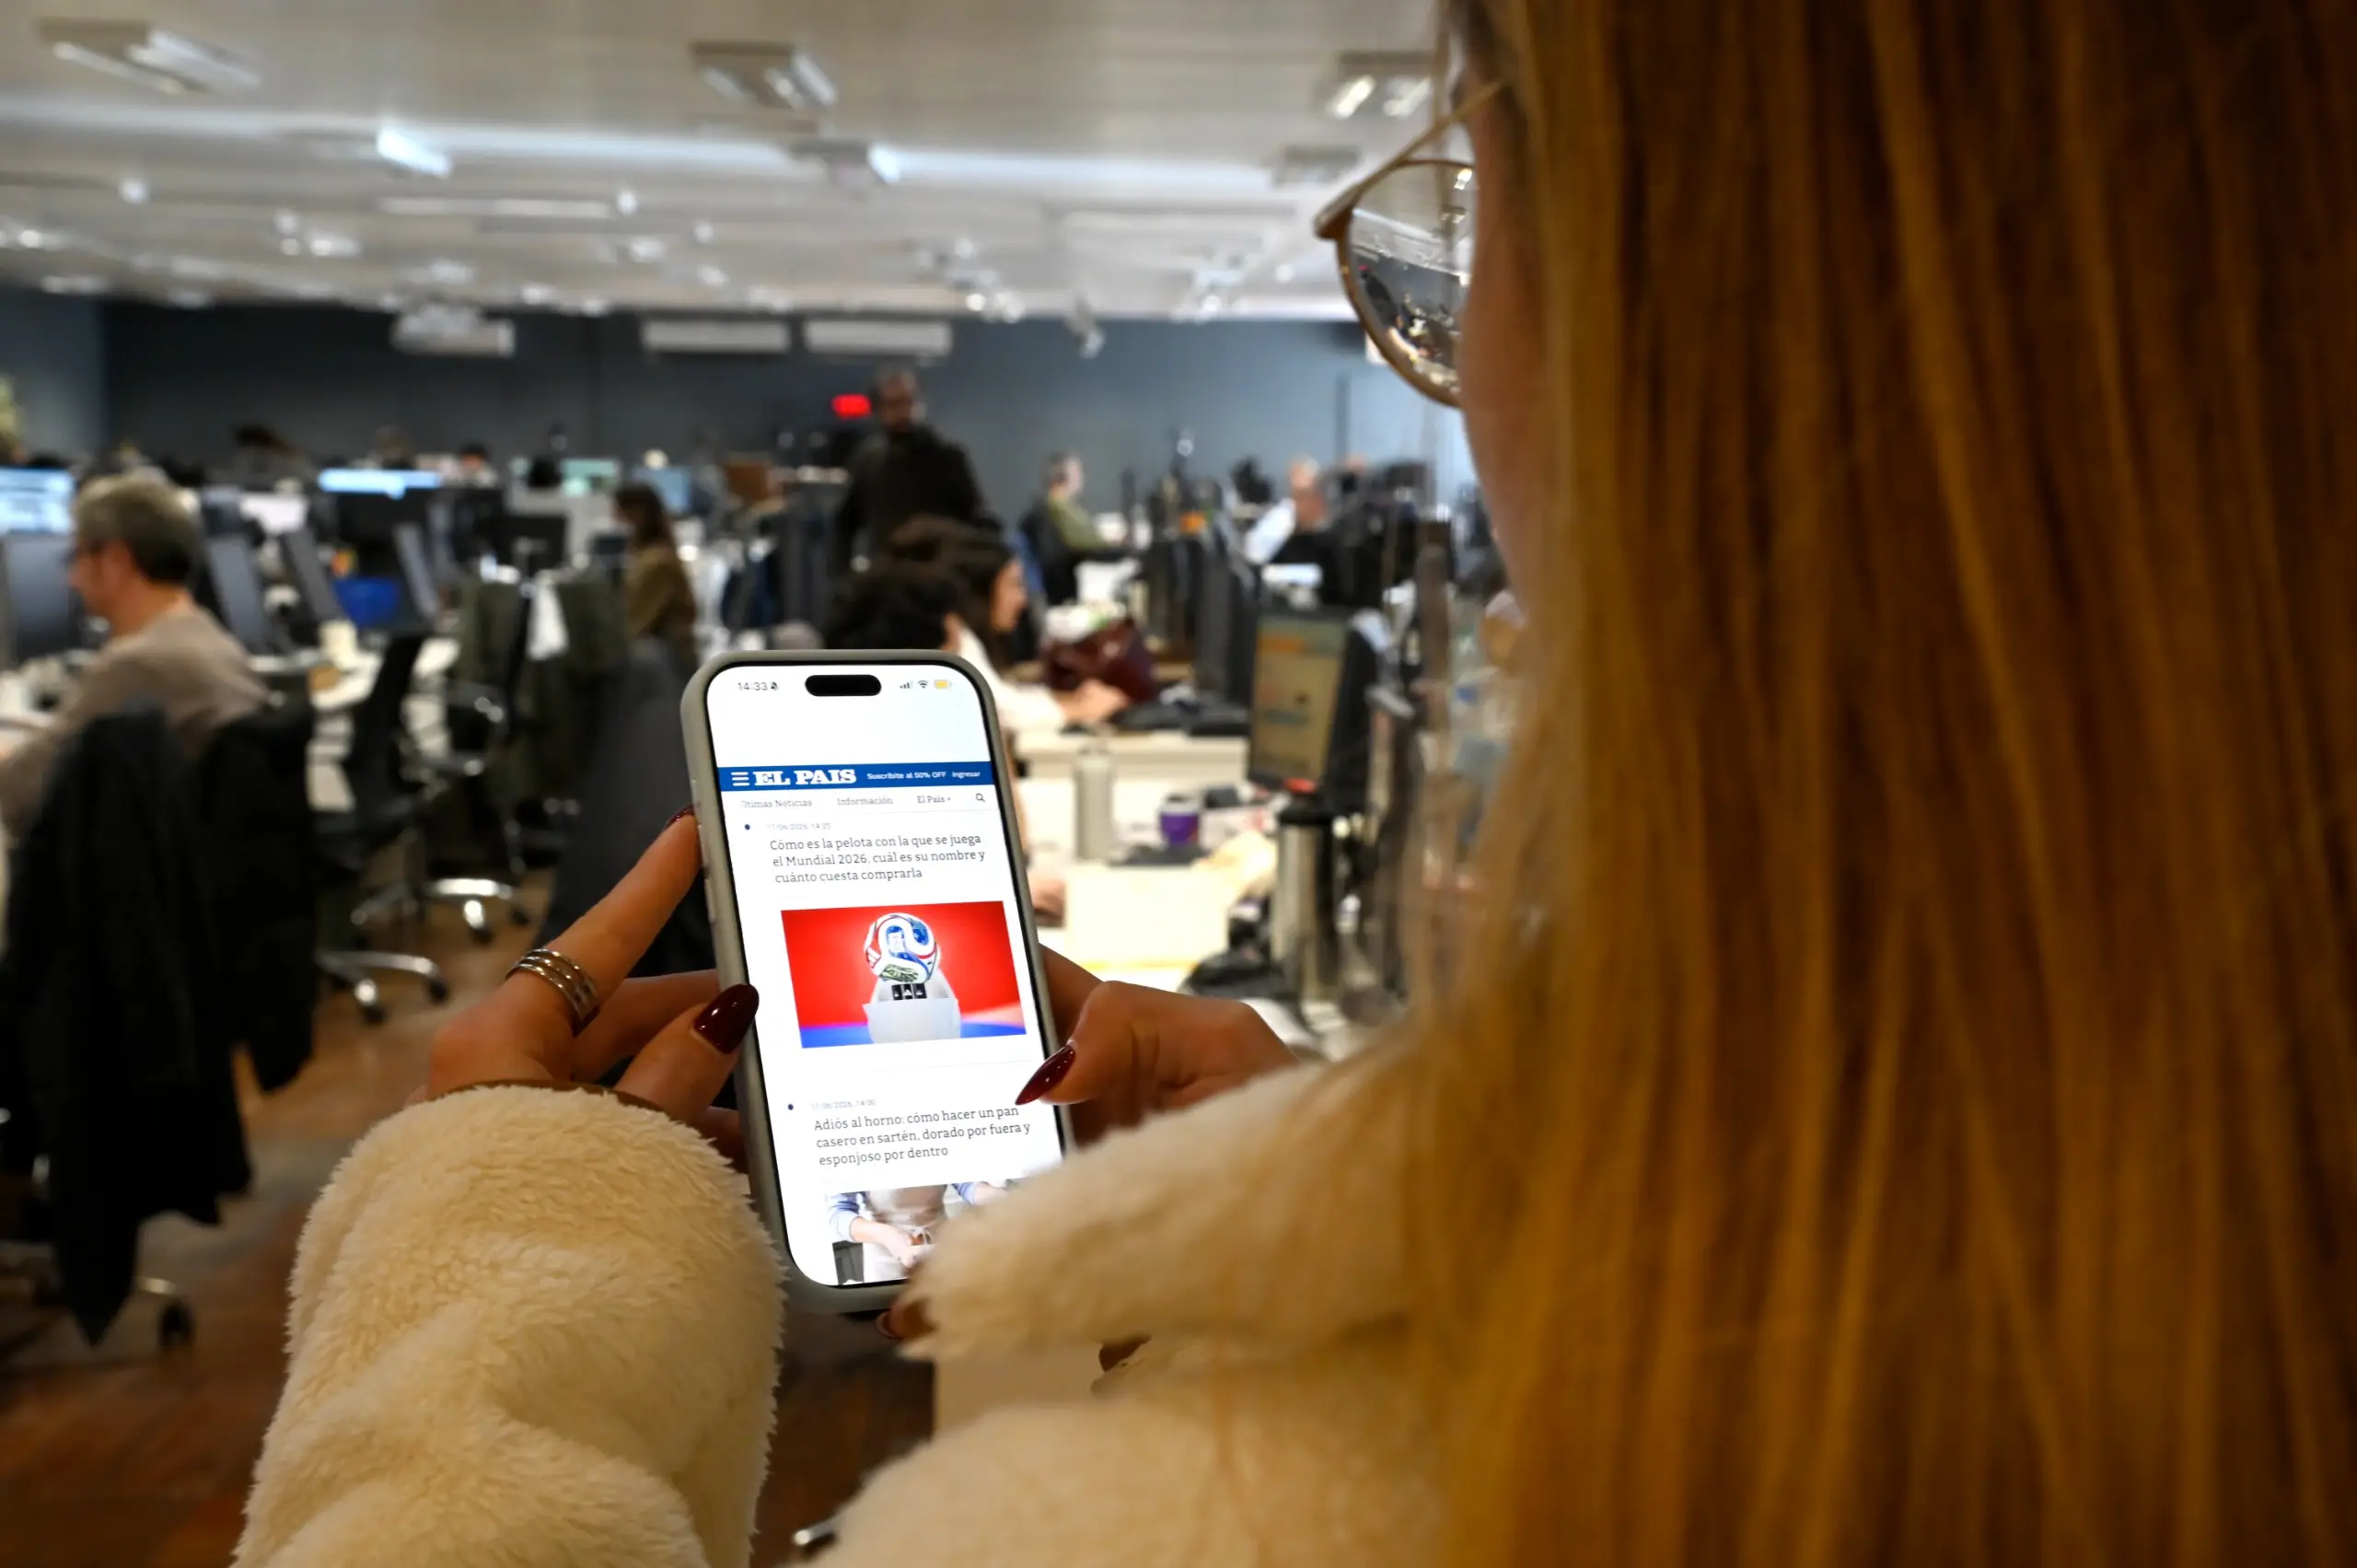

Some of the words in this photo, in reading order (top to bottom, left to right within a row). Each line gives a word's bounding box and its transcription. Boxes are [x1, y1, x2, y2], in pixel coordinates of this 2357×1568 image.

[737, 681, 768, 691] 14:33
[752, 771, 791, 786] EL
[794, 769, 857, 785] PAIS
[775, 797, 812, 807] Noticias
[770, 839, 804, 850] Cómo
[807, 841, 819, 849] es
[821, 838, 832, 848] la
[835, 837, 873, 851] pelota
[875, 838, 897, 847] con
[899, 835, 909, 846] la
[911, 837, 933, 848] que
[935, 836, 947, 844] se
[949, 834, 981, 846] juega
[773, 856, 783, 866] el
[785, 854, 836, 866] Mundial
[839, 854, 871, 865] 2026,
[873, 852, 898, 863] cuál
[900, 853, 912, 862] es
[915, 852, 928, 862] su
[931, 850, 976, 861] nombre
[978, 851, 985, 862] y
[775, 871, 818, 883] cuánto
[819, 871, 859, 881] cuesta
[861, 867, 923, 881] comprarla
[814, 1117, 849, 1131] Adiós
[851, 1116, 862, 1128] al
[865, 1115, 904, 1128] horno:
[907, 1111, 940, 1123] cómo
[941, 1109, 976, 1121] hacer
[978, 1109, 994, 1119] un
[996, 1107, 1019, 1120] pan
[816, 1136, 857, 1148] casero
[859, 1134, 875, 1144] en
[923, 1126, 965, 1140] dorado
[967, 1126, 987, 1139] por
[989, 1123, 1022, 1135] fuera
[1023, 1122, 1030, 1134] y
[819, 1152, 881, 1167] esponjoso
[884, 1150, 904, 1163] por
[907, 1147, 948, 1158] dentro
